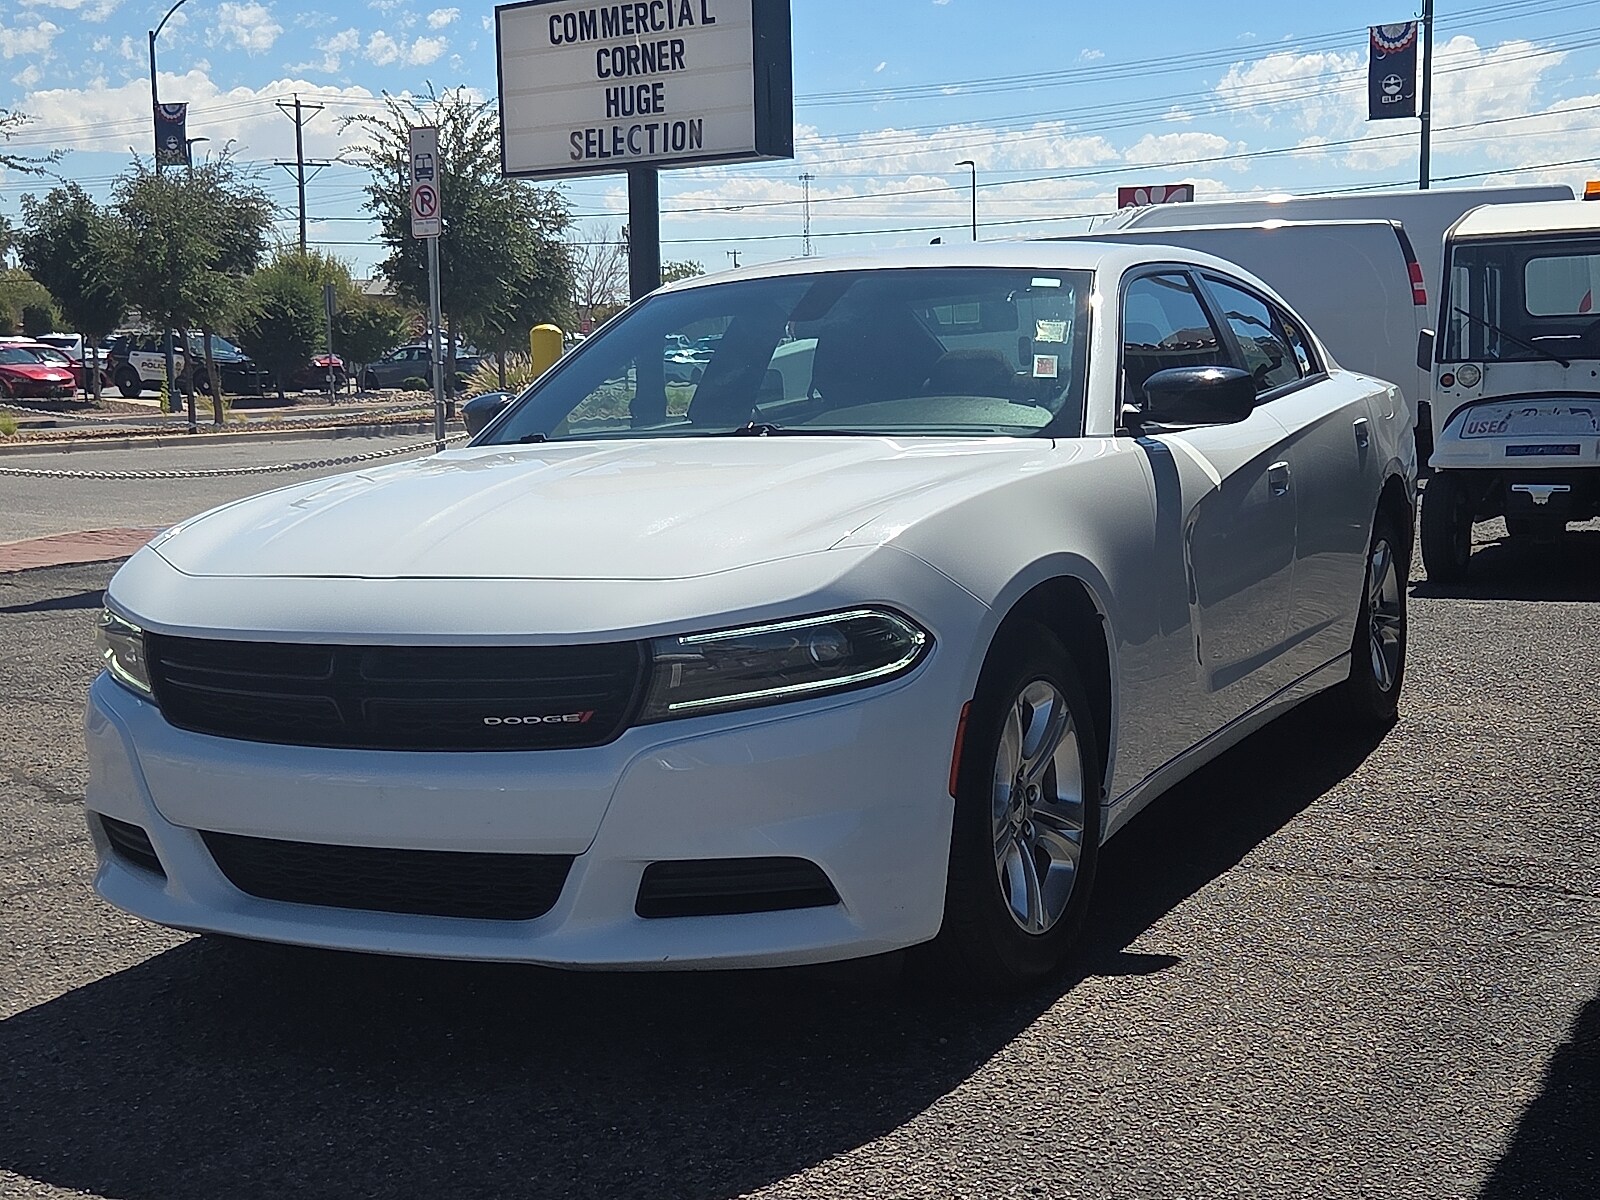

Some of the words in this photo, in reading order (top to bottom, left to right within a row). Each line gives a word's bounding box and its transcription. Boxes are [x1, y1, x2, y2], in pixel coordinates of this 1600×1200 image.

[549, 0, 716, 45] COMMERCIAL
[596, 38, 685, 79] CORNER
[605, 82, 665, 118] HUGE
[1381, 94, 1403, 104] ELP
[570, 118, 703, 161] SELECTION
[141, 361, 167, 370] POLIC
[1467, 419, 1508, 434] USED
[483, 713, 581, 725] DODGE
